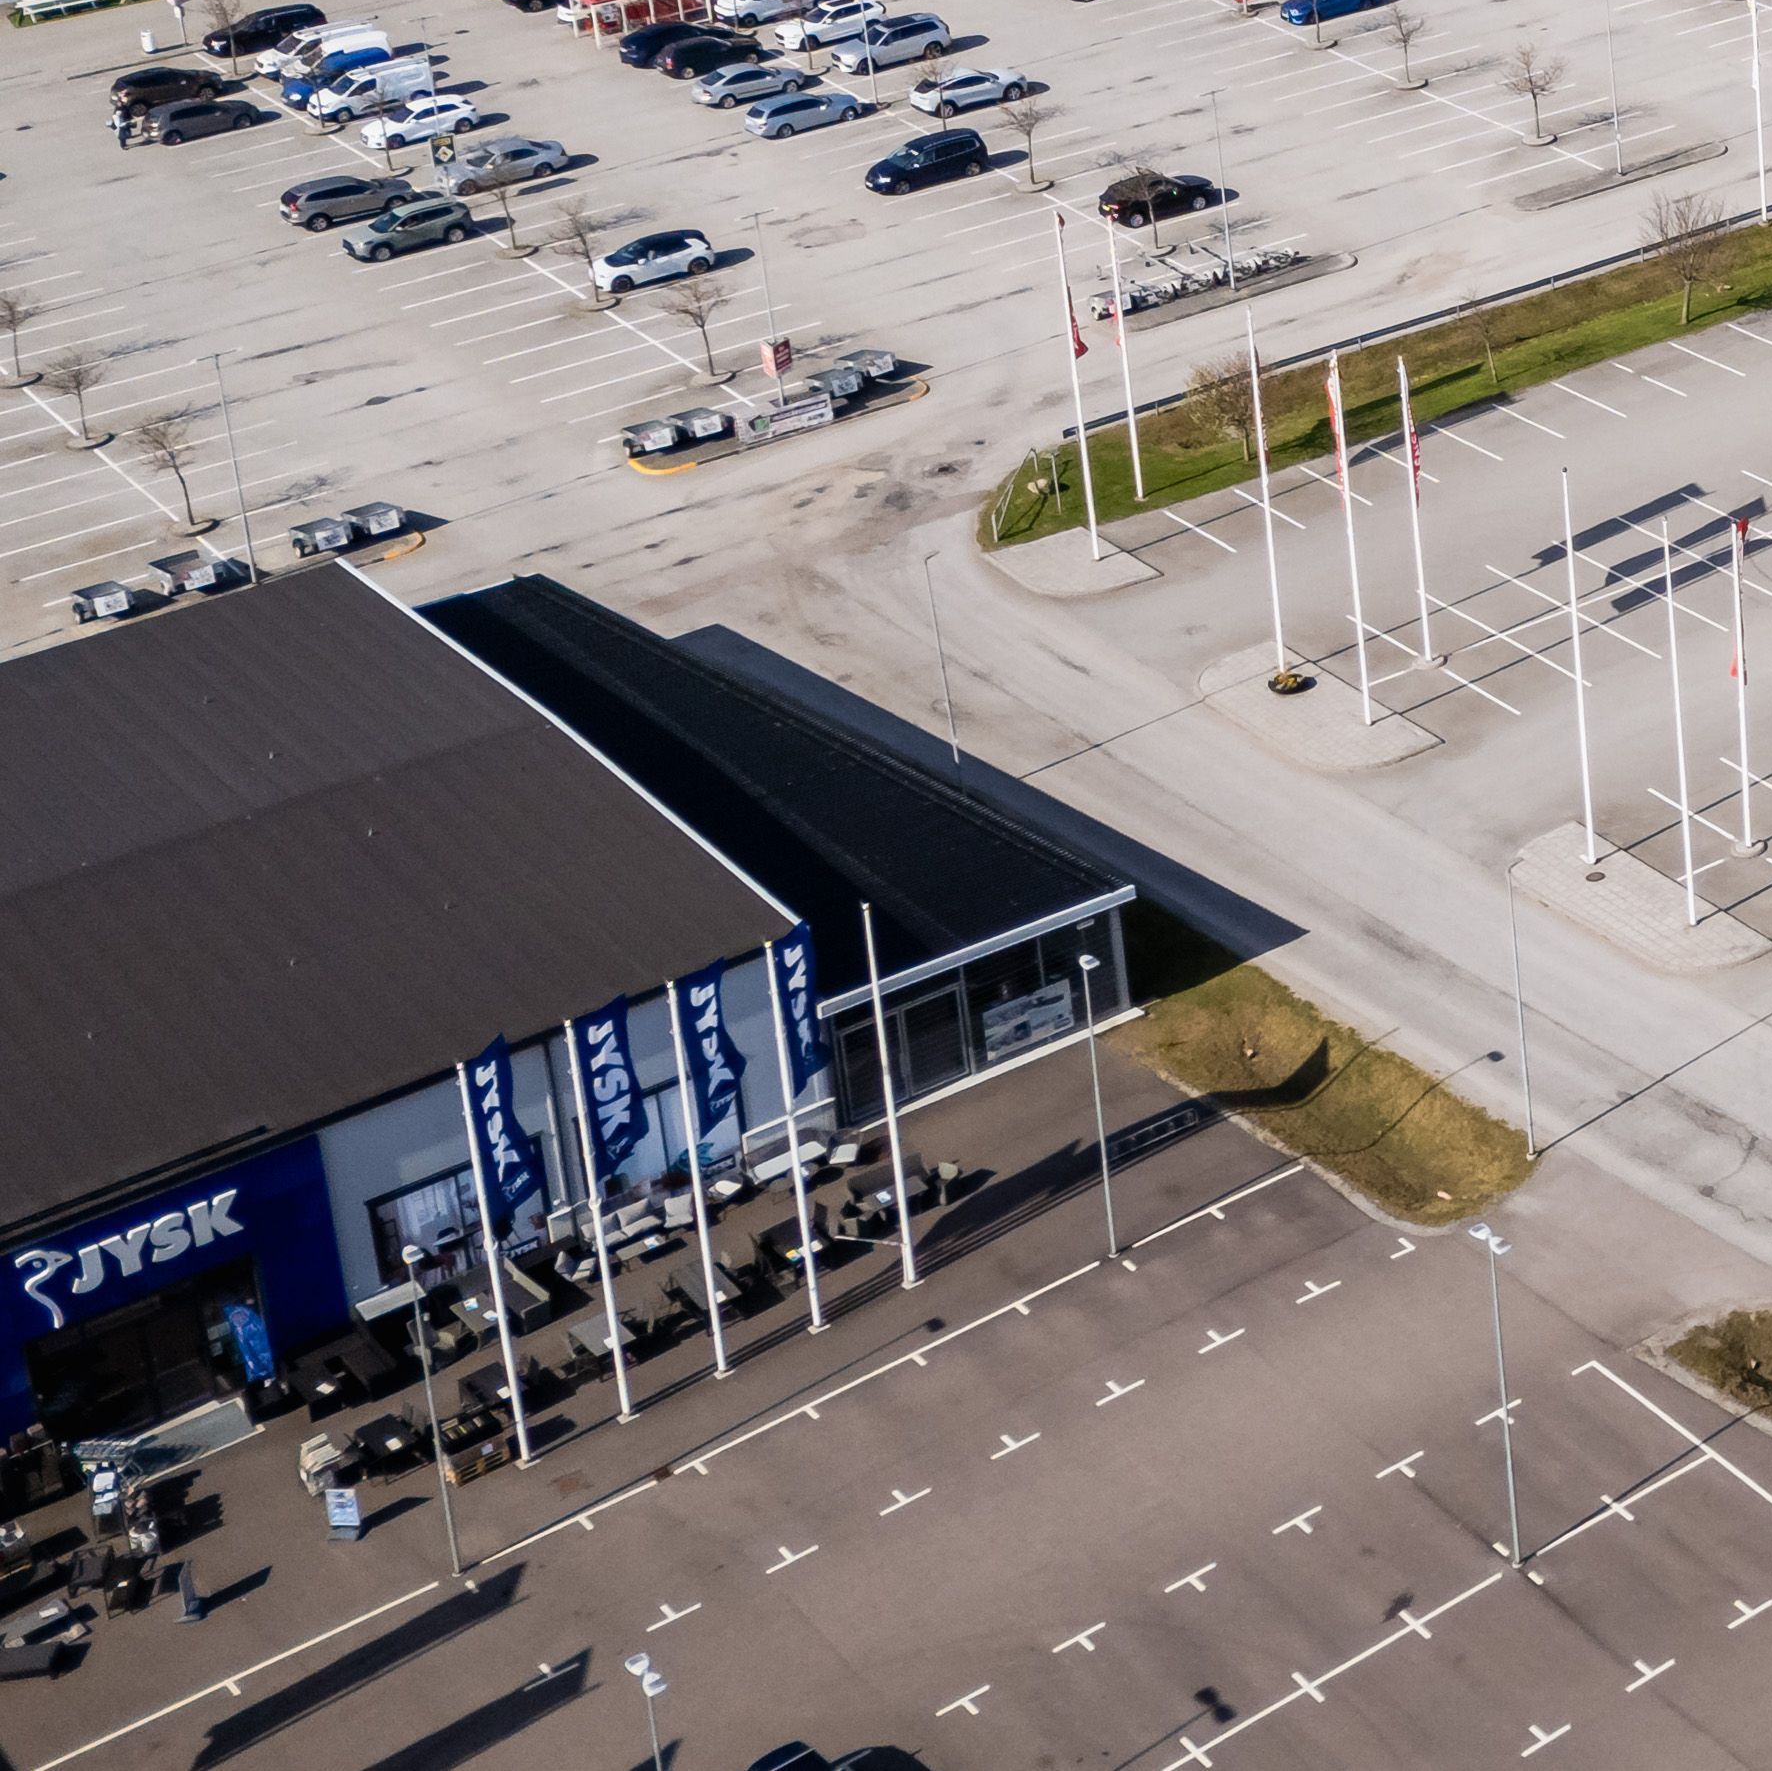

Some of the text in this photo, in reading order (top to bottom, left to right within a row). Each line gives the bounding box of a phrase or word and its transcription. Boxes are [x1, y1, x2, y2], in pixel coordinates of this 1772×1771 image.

[475, 1059, 521, 1183] JYSK
[588, 1019, 632, 1140] JYSK
[72, 1188, 245, 1294] JYSK
